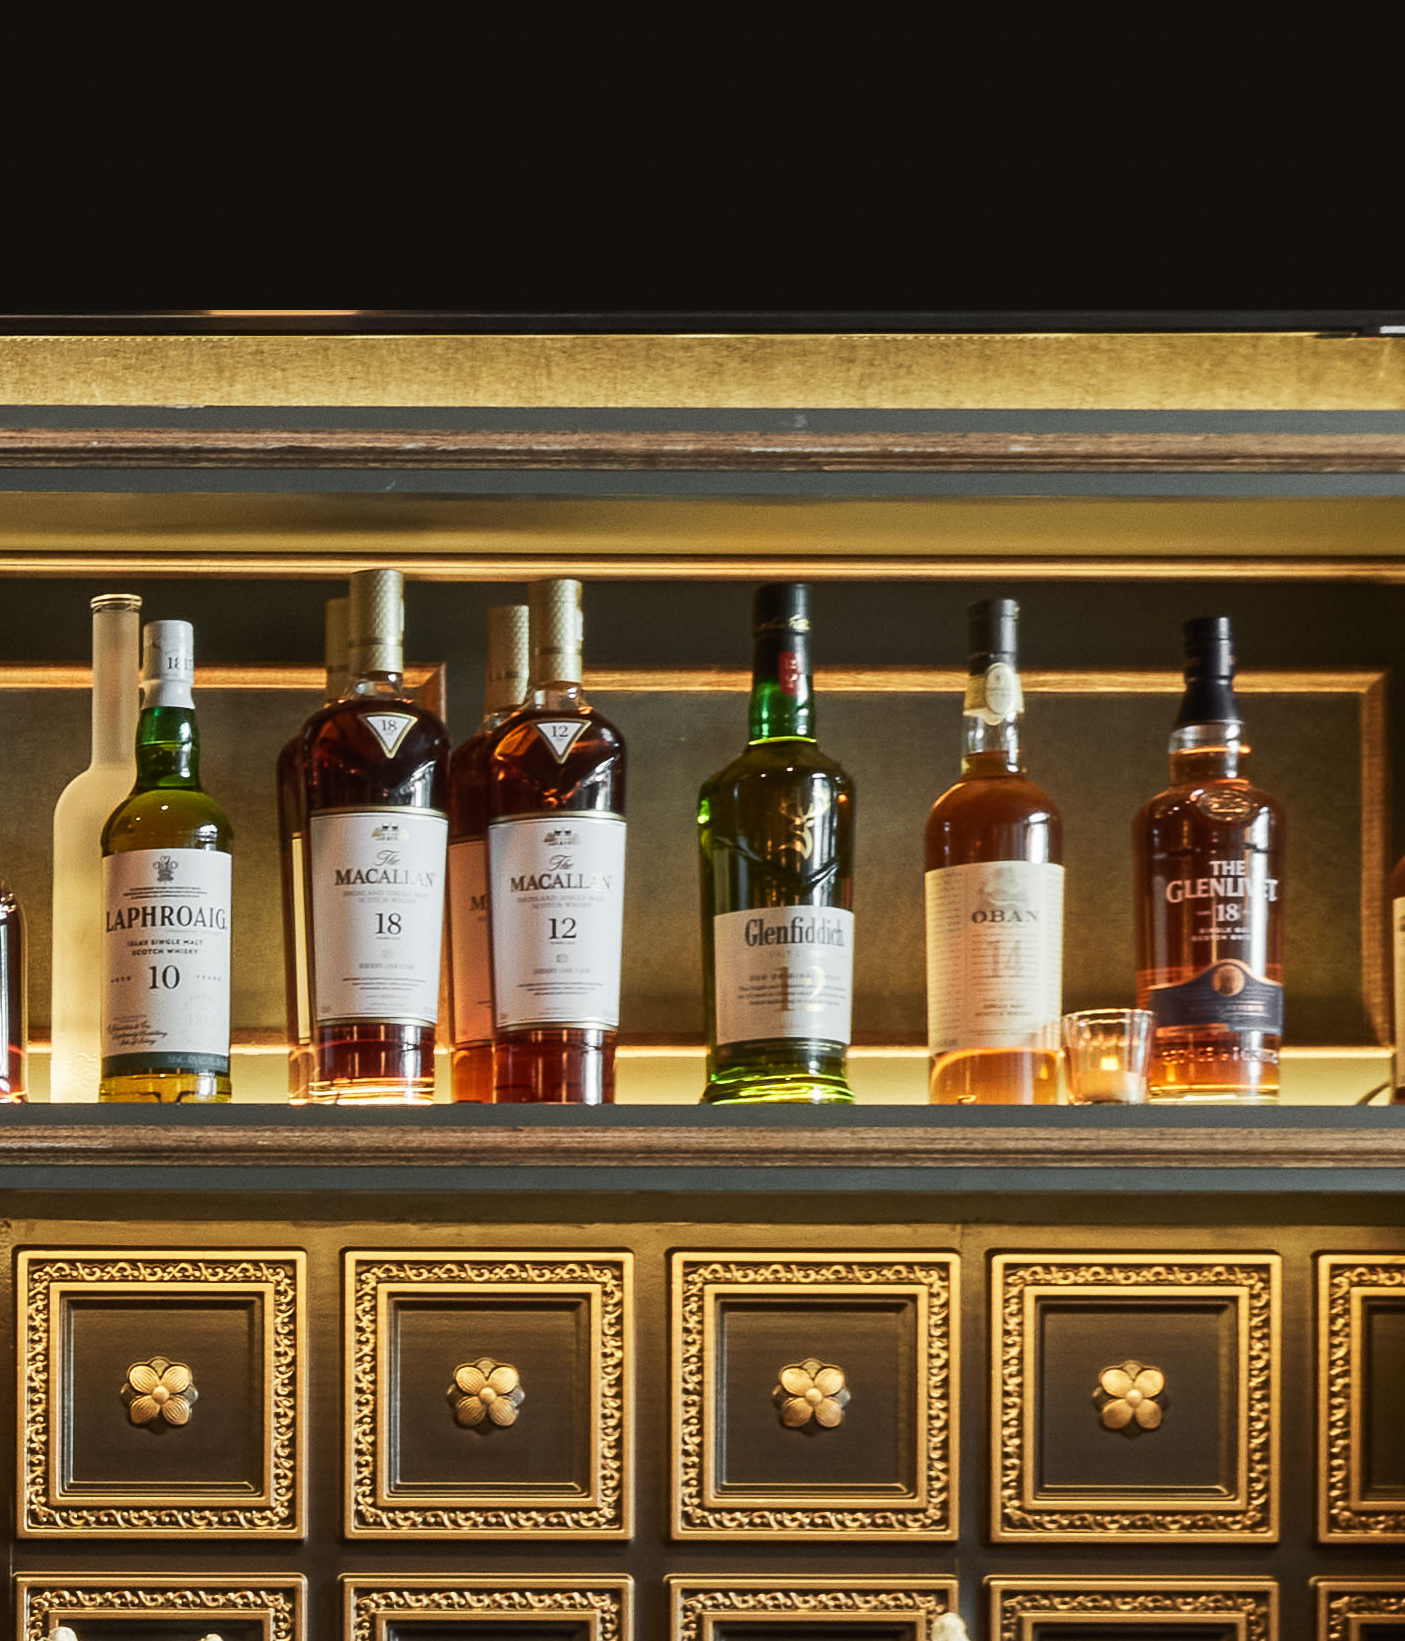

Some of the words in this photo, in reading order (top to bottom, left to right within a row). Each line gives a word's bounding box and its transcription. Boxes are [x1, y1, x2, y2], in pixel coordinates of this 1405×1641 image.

[380, 720, 397, 732] 18
[550, 726, 568, 738] 12
[375, 849, 401, 866] The
[548, 854, 575, 871] The
[334, 868, 435, 886] MACALLAN
[1209, 860, 1247, 876] THE
[510, 873, 612, 892] MACALLAN
[1165, 877, 1279, 903] GLENLIVET
[105, 904, 227, 933] LAPHROAIG
[971, 909, 1038, 924] OBAN
[1216, 903, 1239, 922] 18
[375, 913, 402, 934] 18
[548, 918, 577, 939] 12
[745, 916, 845, 947] Glenfiddich
[131, 947, 164, 956] SCOTCH
[148, 964, 181, 990] 10
